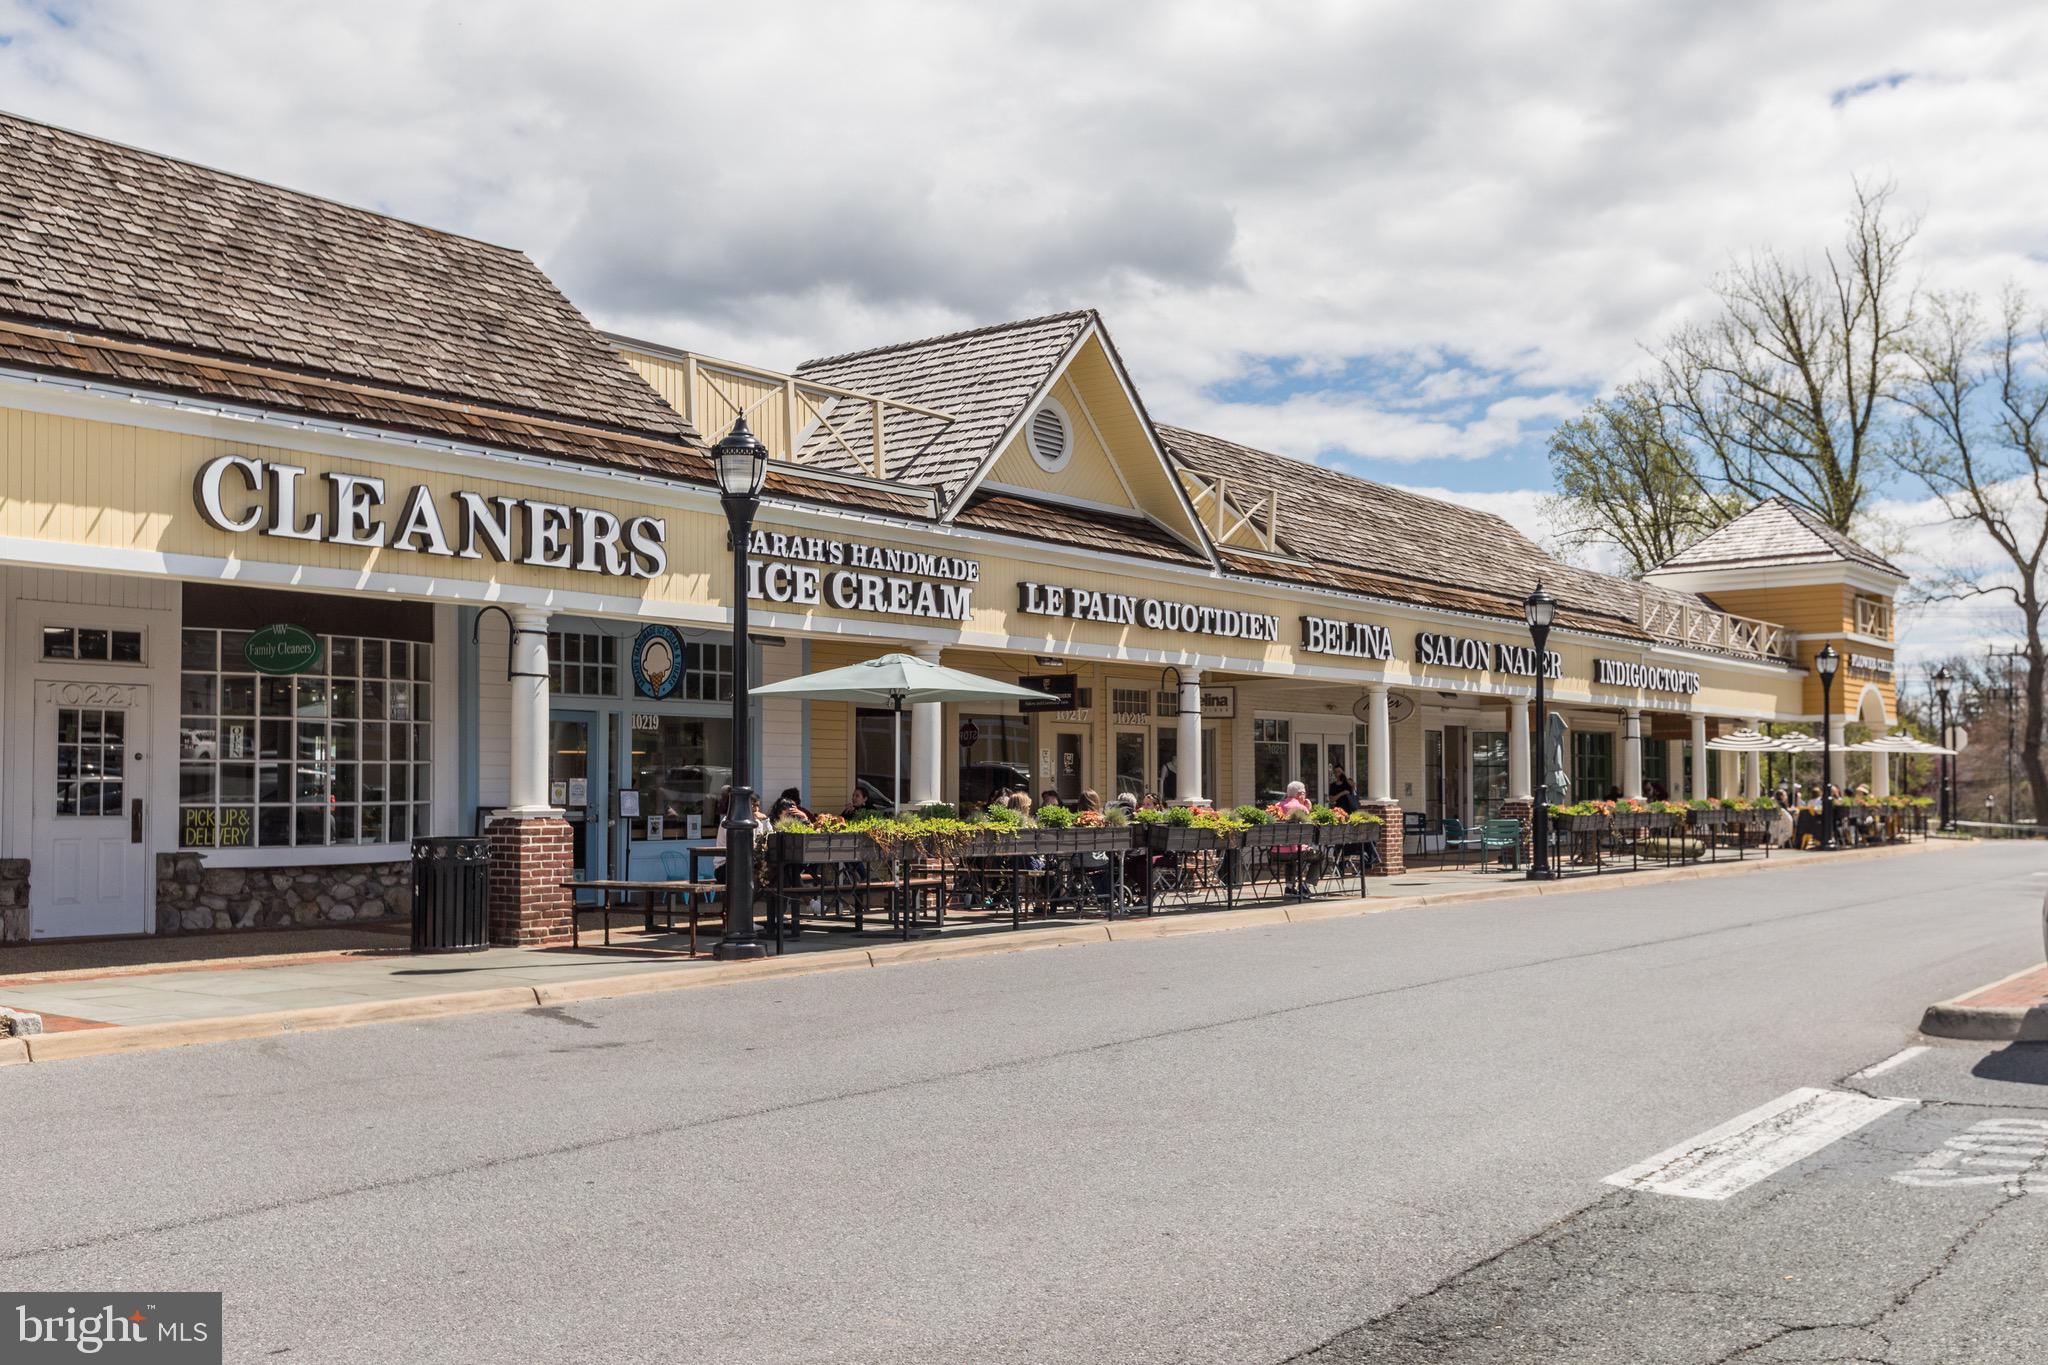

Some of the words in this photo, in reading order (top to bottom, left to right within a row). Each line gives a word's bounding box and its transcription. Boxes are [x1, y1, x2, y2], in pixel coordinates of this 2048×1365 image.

[195, 454, 667, 579] CLEANERS
[850, 543, 980, 583] HANDMADE
[747, 559, 820, 605] ICE
[826, 569, 974, 622] CREAM
[1019, 582, 1064, 616] LE
[1068, 588, 1136, 625] PAIN
[1139, 598, 1280, 642] QUOTIDIEN
[249, 642, 276, 658] Family
[277, 642, 312, 655] Cleaners
[1302, 615, 1396, 662] BELINA
[1418, 632, 1491, 671] SALON
[1497, 643, 1563, 680] NADER
[1596, 659, 1701, 695] INDIGOOCTOPUS
[46, 683, 139, 707] 10221
[1200, 693, 1228, 707] elina
[631, 714, 660, 730] 10219
[1056, 709, 1089, 721] 10217
[232, 727, 242, 758] OPEN
[186, 808, 216, 827] PICK
